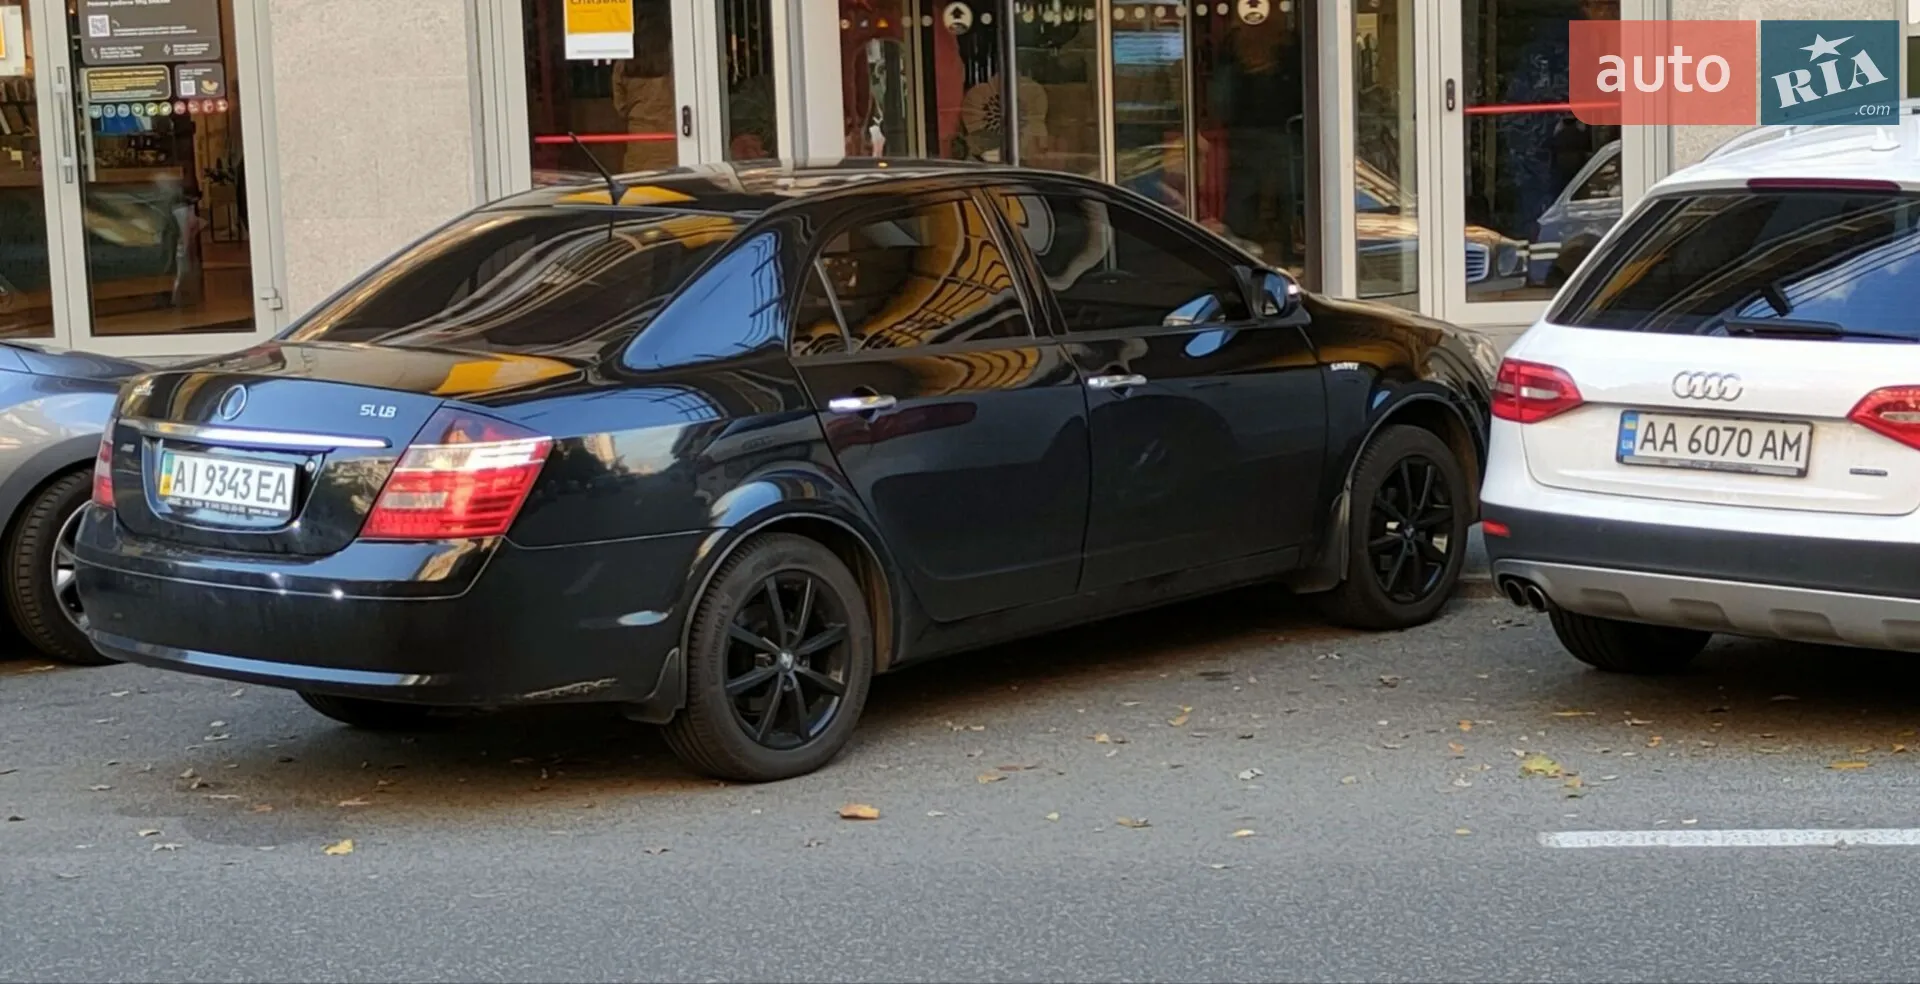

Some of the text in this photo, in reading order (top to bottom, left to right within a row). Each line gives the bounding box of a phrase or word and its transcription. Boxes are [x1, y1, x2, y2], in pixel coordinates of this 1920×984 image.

[1640, 420, 1804, 462] AA 6070 AM
[173, 461, 288, 505] AI 9343 EA
